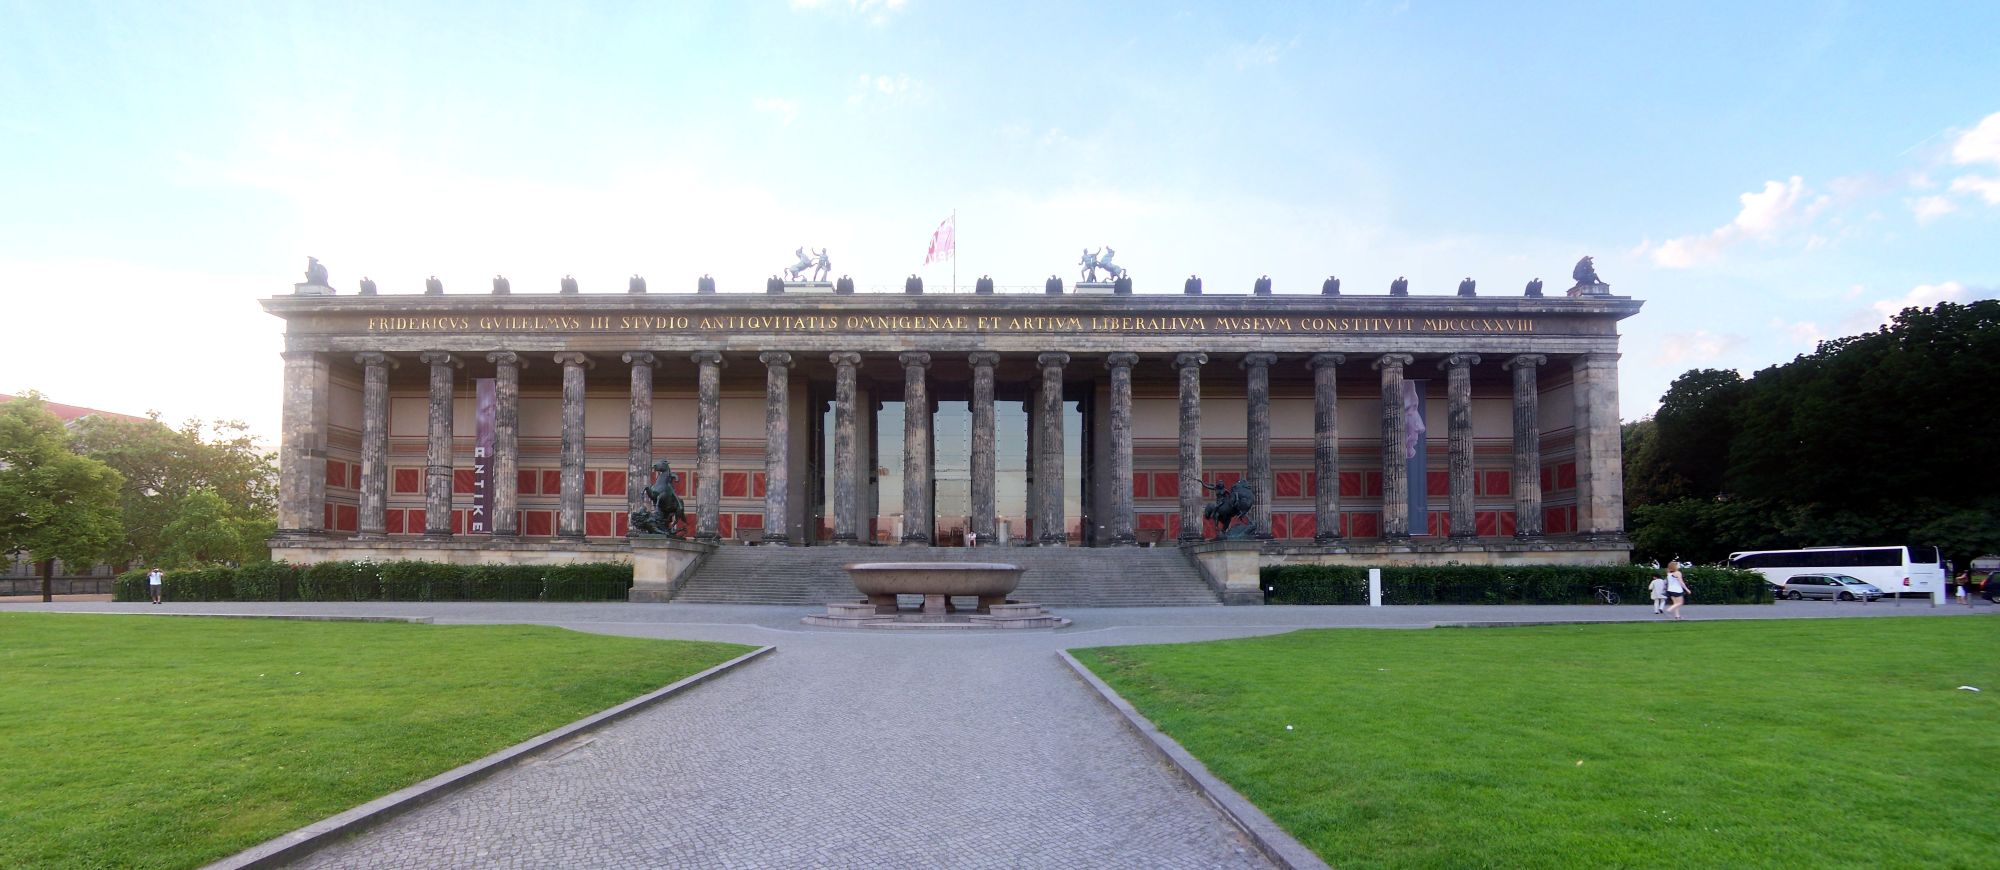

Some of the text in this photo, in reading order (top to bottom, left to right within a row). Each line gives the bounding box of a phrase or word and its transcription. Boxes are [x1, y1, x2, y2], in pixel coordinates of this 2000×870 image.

[368, 317, 1533, 331] FRIDERICVS GVILELMVS III STVDIO ANTIQVITATIS OMNIGENAE ET ARTIVM LIBERALIVM MVSEVM CONSTITVIT MDCCCXXVIII
[473, 447, 485, 531] ANTIKE
